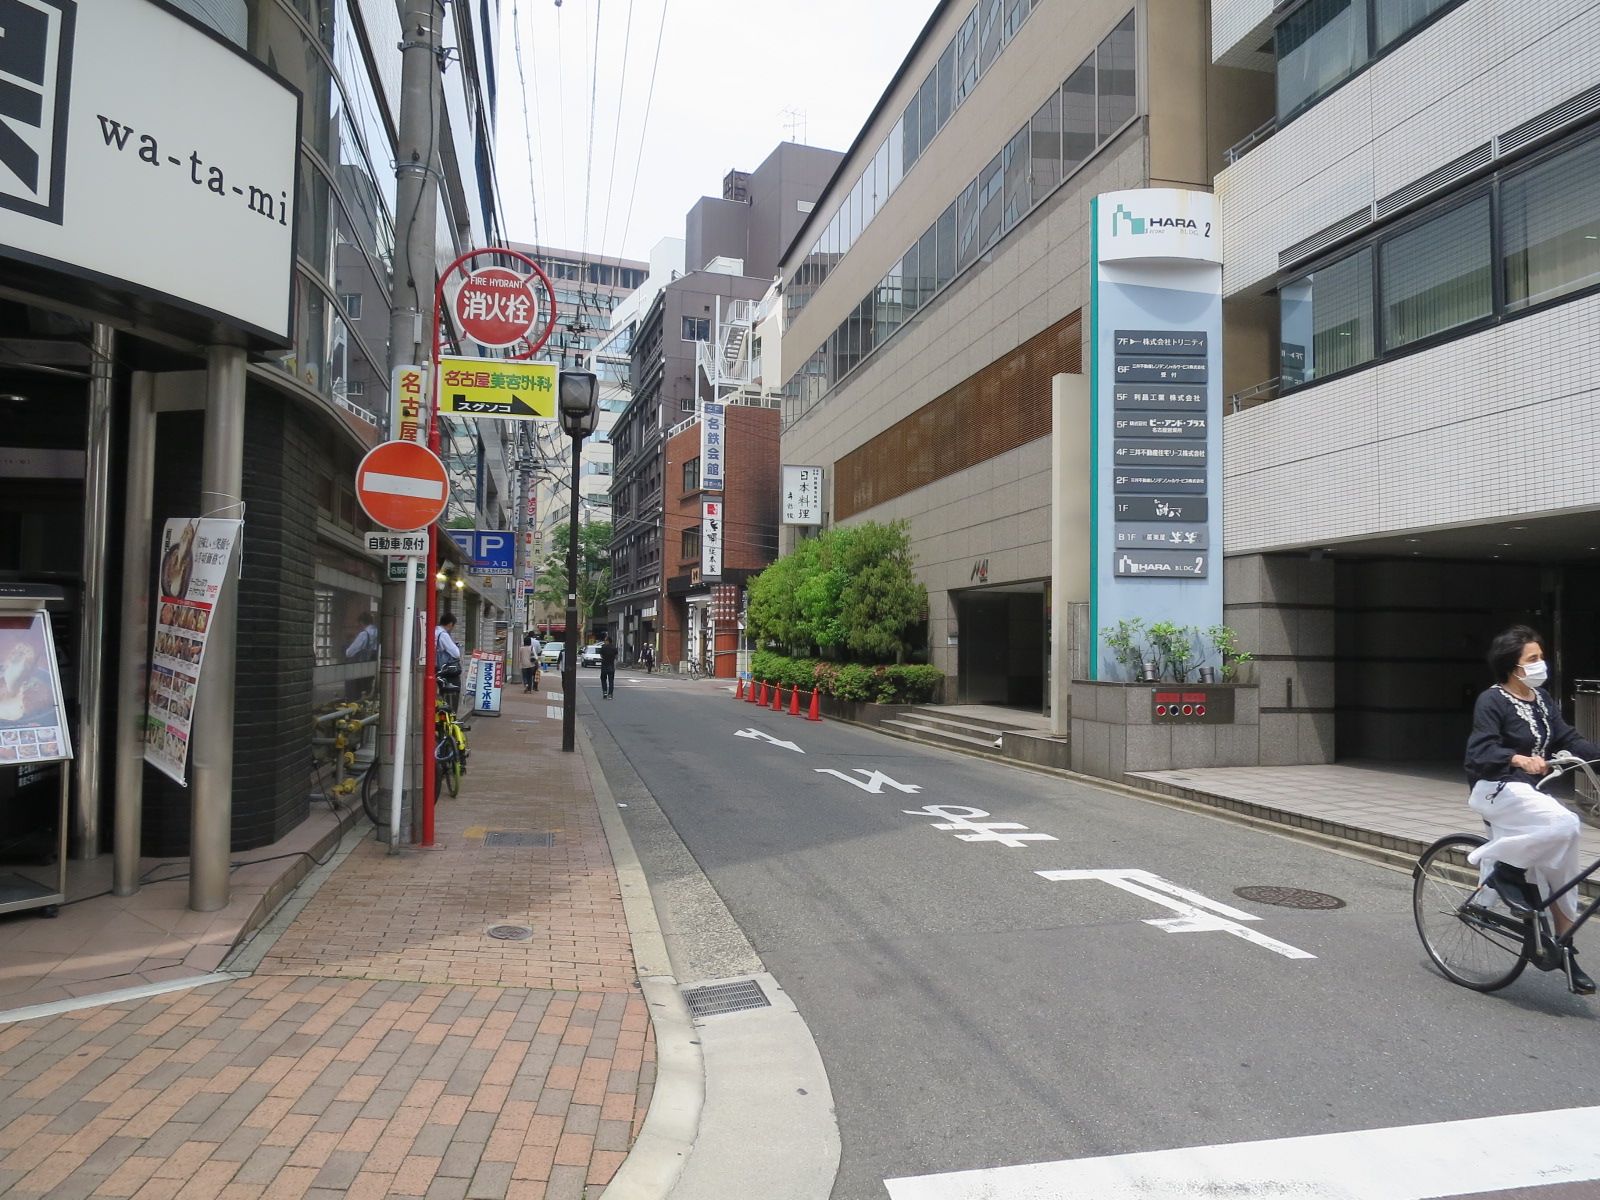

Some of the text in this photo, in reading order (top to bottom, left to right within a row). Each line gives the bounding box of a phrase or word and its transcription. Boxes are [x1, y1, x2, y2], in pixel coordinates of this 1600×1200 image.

[96, 114, 288, 226] wa-ta-mi
[1149, 217, 1211, 238] HARA 2
[470, 276, 524, 289] FIRE HYDRANT
[463, 290, 531, 325] 消火栓
[1117, 338, 1129, 346] 7F
[1142, 338, 1204, 347] 株式会社トリニティ
[1117, 365, 1130, 373] 6F
[444, 370, 553, 393] 名古屋美容外科
[1116, 393, 1128, 401] 5F
[1169, 394, 1201, 402] 株式会社
[457, 402, 511, 413] スグソコ
[707, 417, 720, 476] 名鉄会館
[1116, 448, 1128, 456] 4F
[1116, 476, 1128, 484] 2F
[798, 470, 811, 519] 日本料理
[1118, 504, 1129, 512] 1F
[368, 536, 424, 551] 自動車・原付
[480, 536, 504, 557] P
[492, 559, 508, 567] 入口
[1139, 563, 1171, 571] HARA
[1194, 556, 1204, 574] 2
